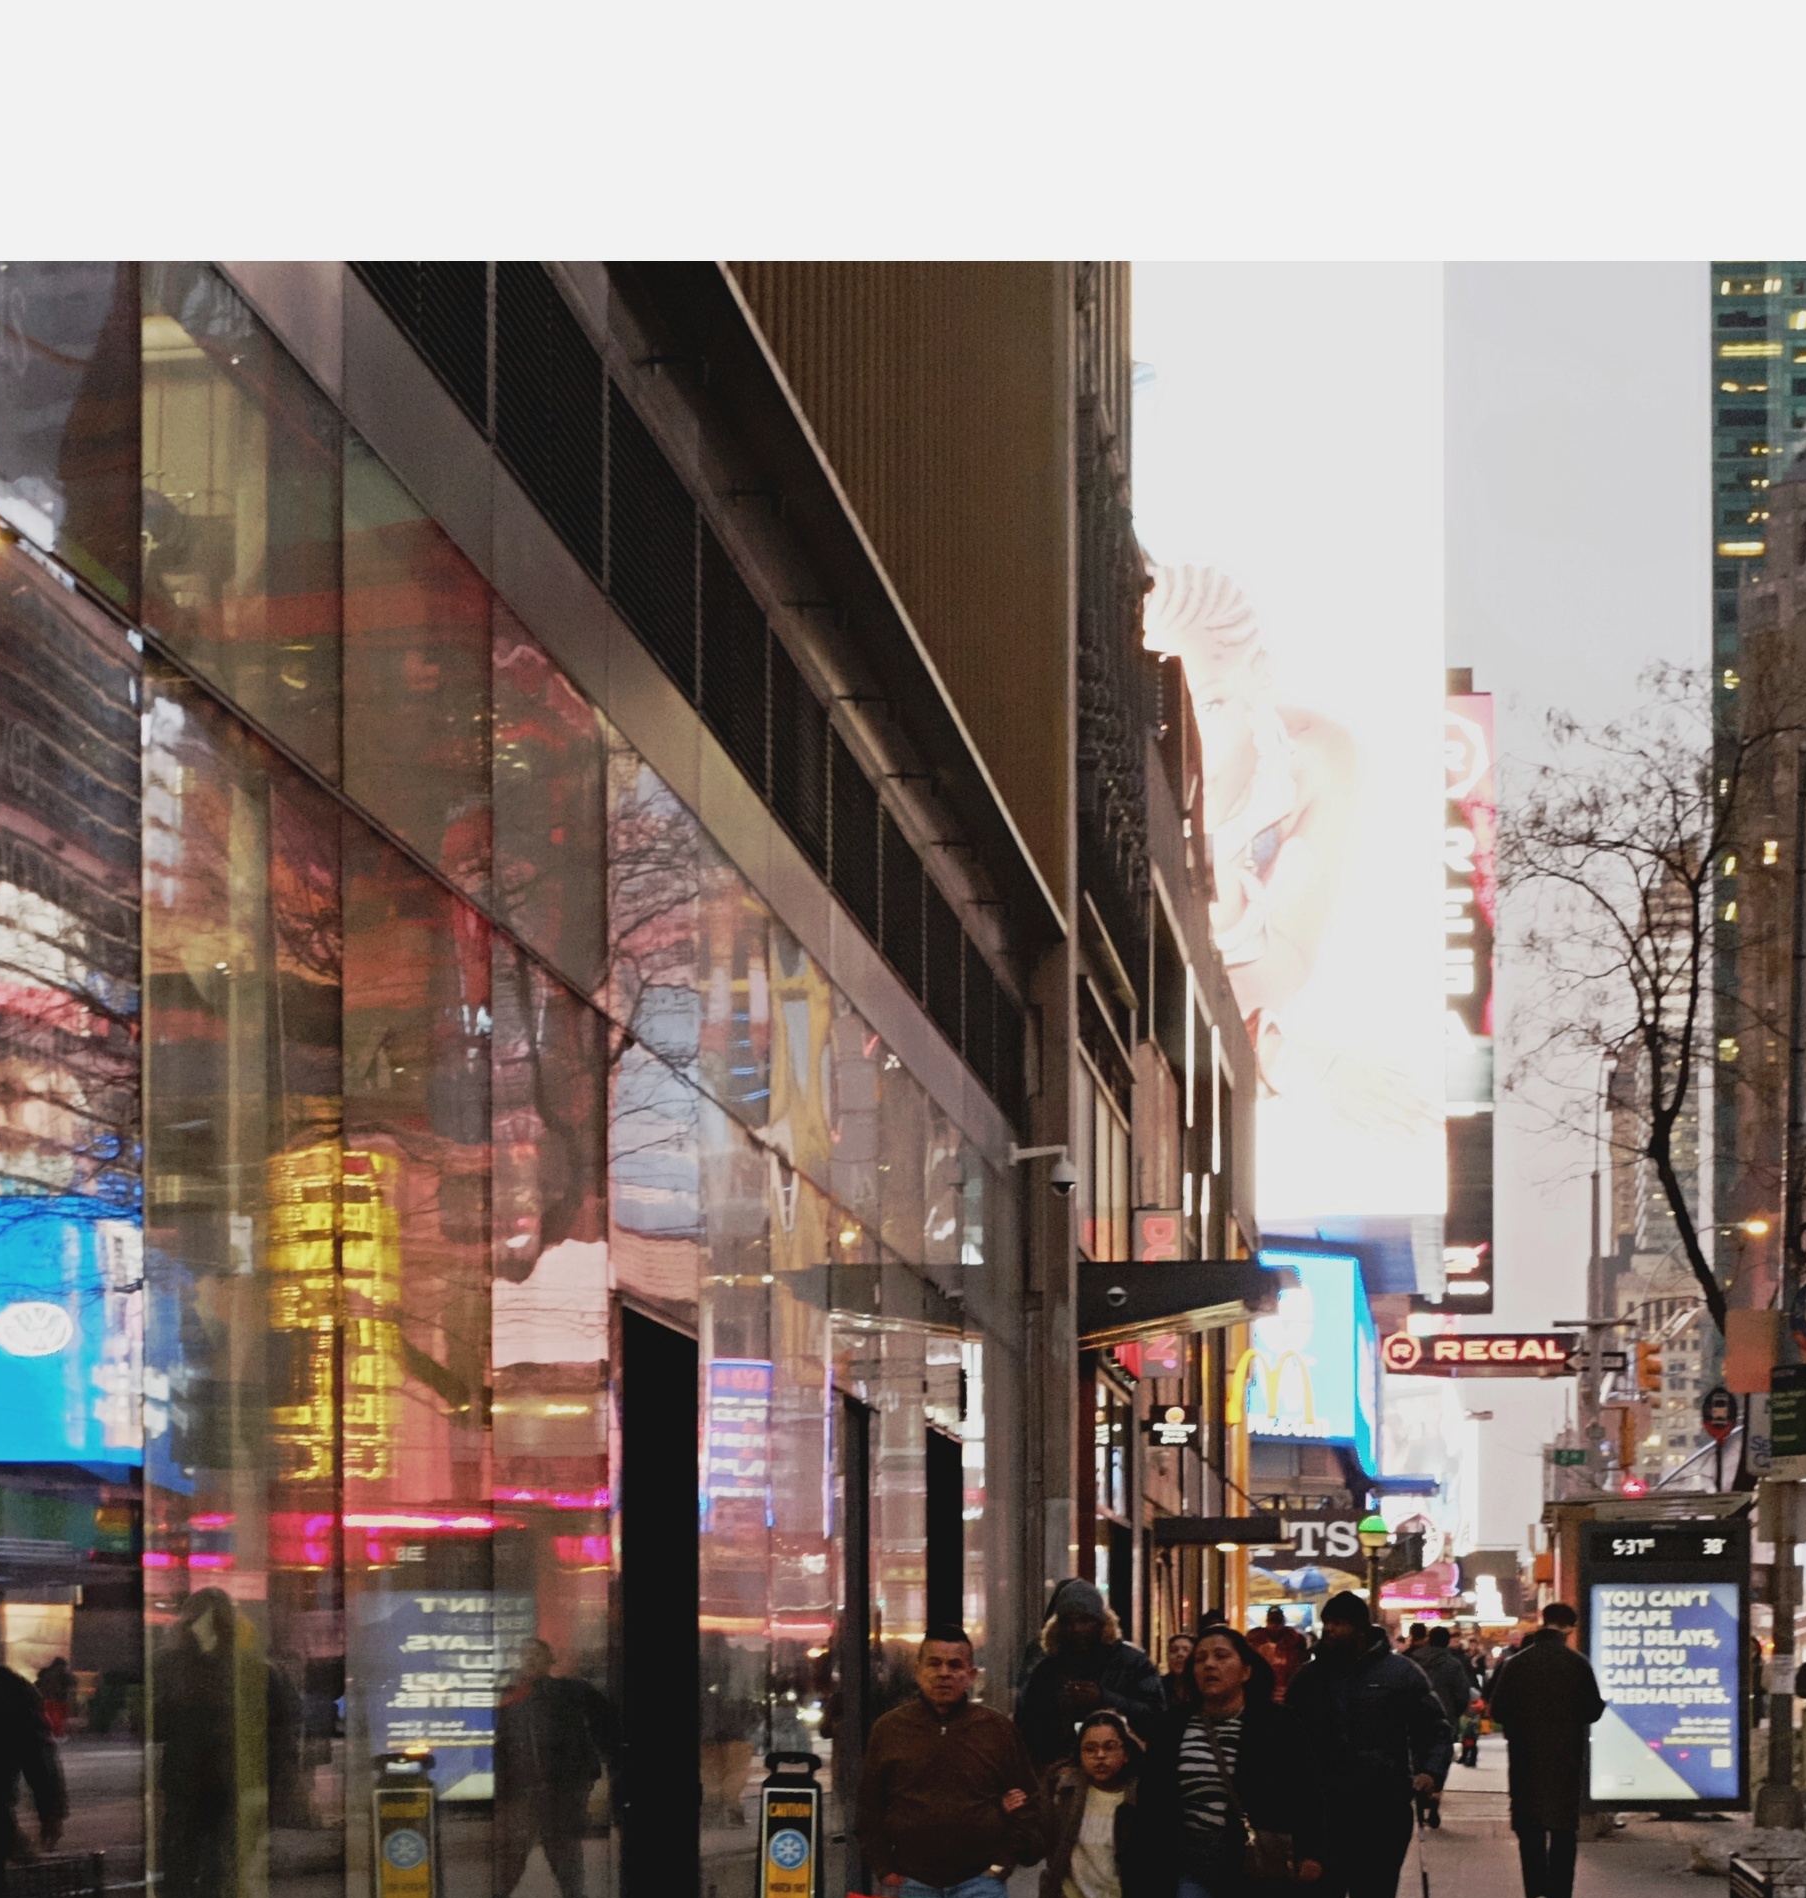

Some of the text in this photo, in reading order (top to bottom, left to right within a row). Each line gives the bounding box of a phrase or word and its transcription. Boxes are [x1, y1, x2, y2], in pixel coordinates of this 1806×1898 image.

[1433, 1339, 1567, 1361] REGAL
[1600, 1590, 1710, 1607] YOU CAN'T
[1600, 1610, 1673, 1627] ESCAPE
[1600, 1629, 1721, 1649] BUS DELAYS,
[1600, 1649, 1687, 1666] BUT YOU
[1600, 1667, 1720, 1685] CAN ESCAPE
